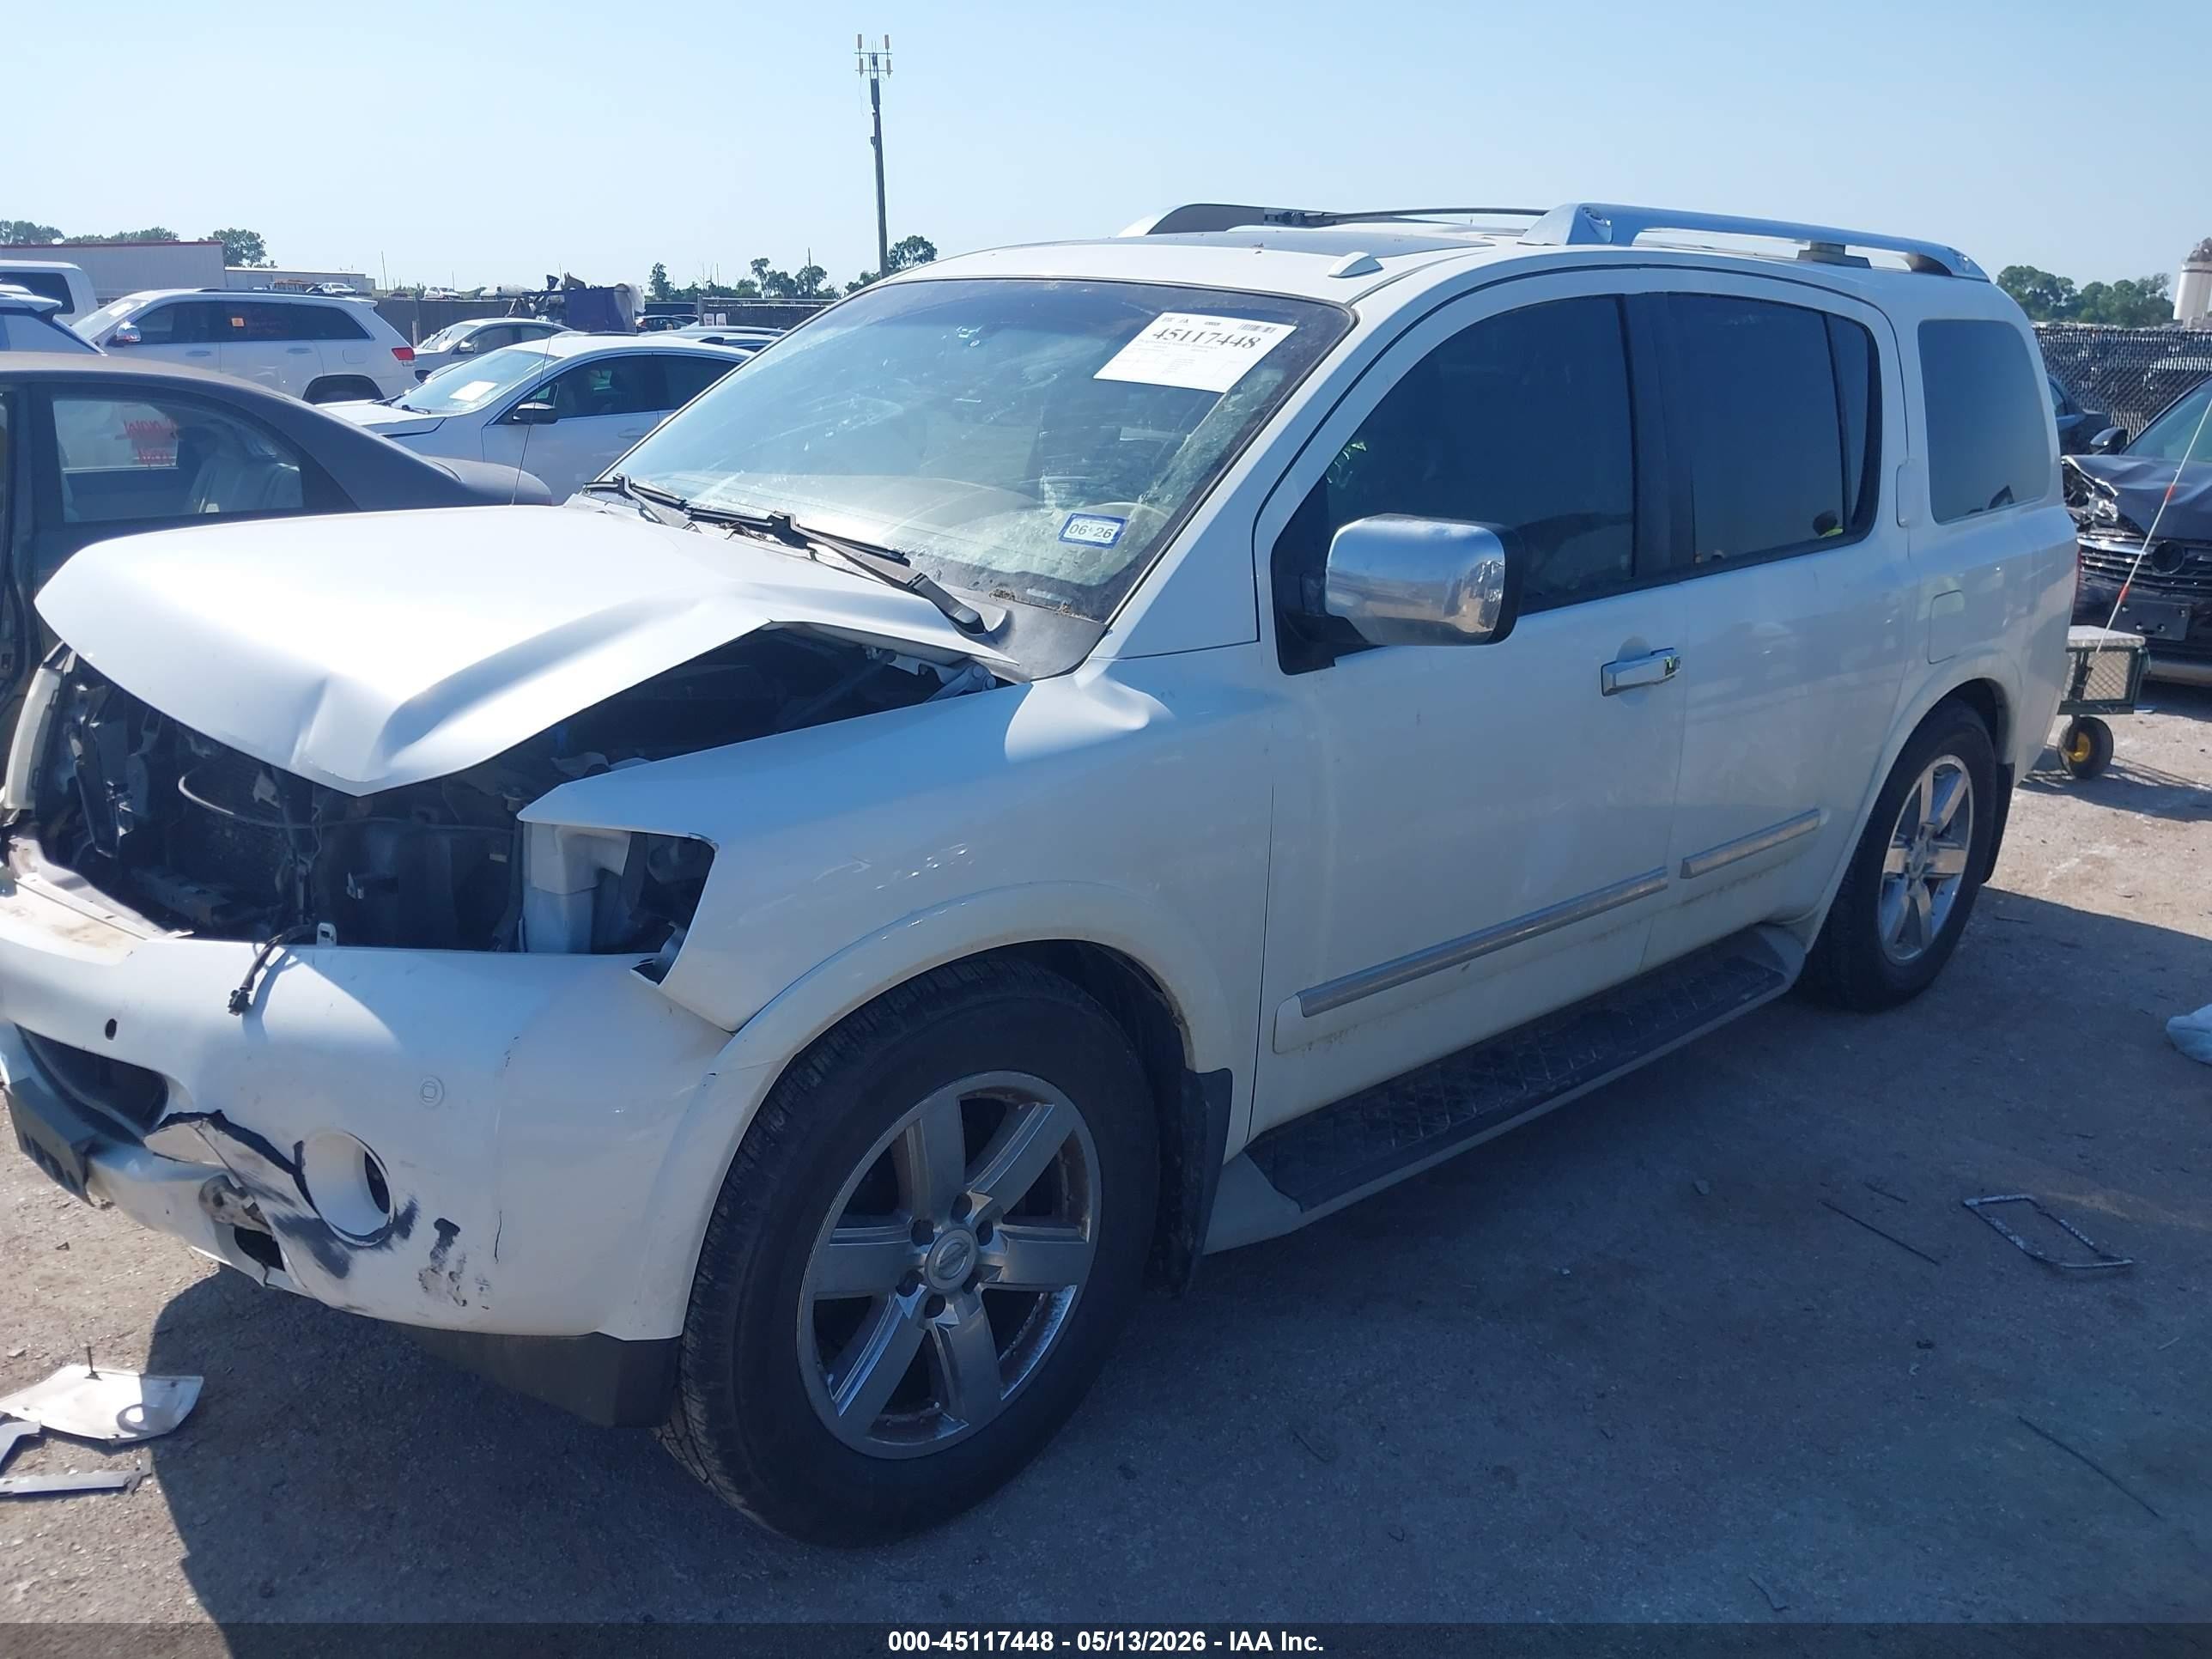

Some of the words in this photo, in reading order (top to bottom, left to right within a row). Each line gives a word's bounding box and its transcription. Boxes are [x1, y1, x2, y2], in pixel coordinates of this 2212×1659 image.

[1152, 327, 1261, 349] 45117448
[1068, 524, 1089, 535] 06
[1093, 527, 1114, 538] 26
